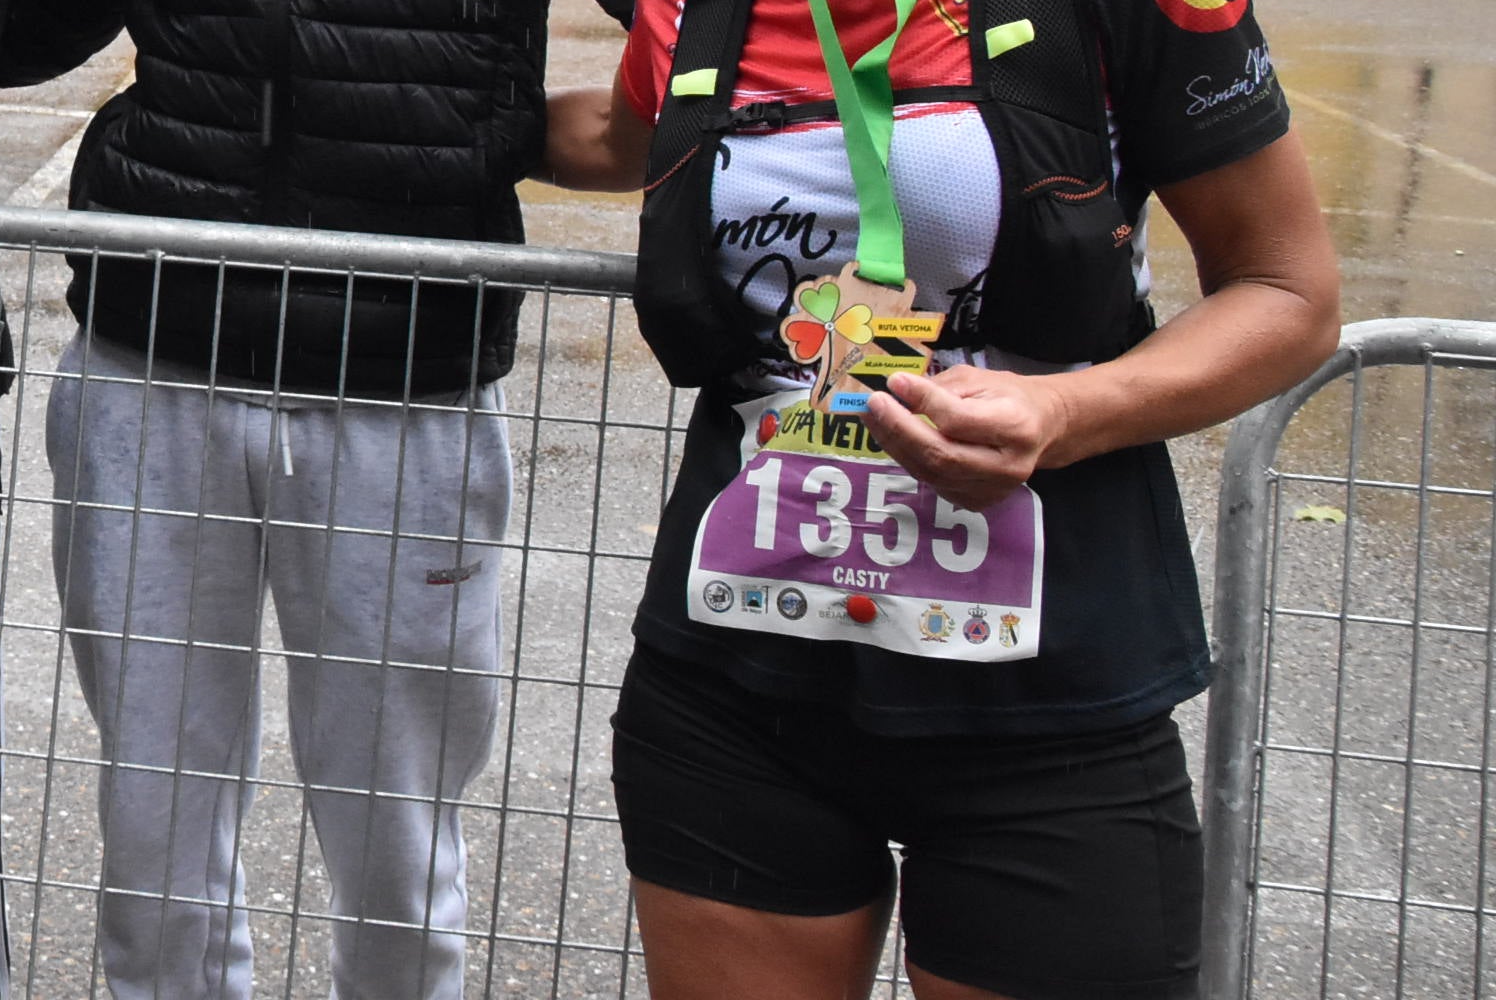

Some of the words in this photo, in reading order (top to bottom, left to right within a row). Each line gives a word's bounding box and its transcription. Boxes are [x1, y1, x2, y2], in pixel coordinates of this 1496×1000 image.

[878, 323, 898, 332] RUTA
[900, 324, 932, 333] VETONA
[776, 408, 816, 444] UTA
[745, 458, 989, 574] 1355
[832, 565, 892, 591] CASTY
